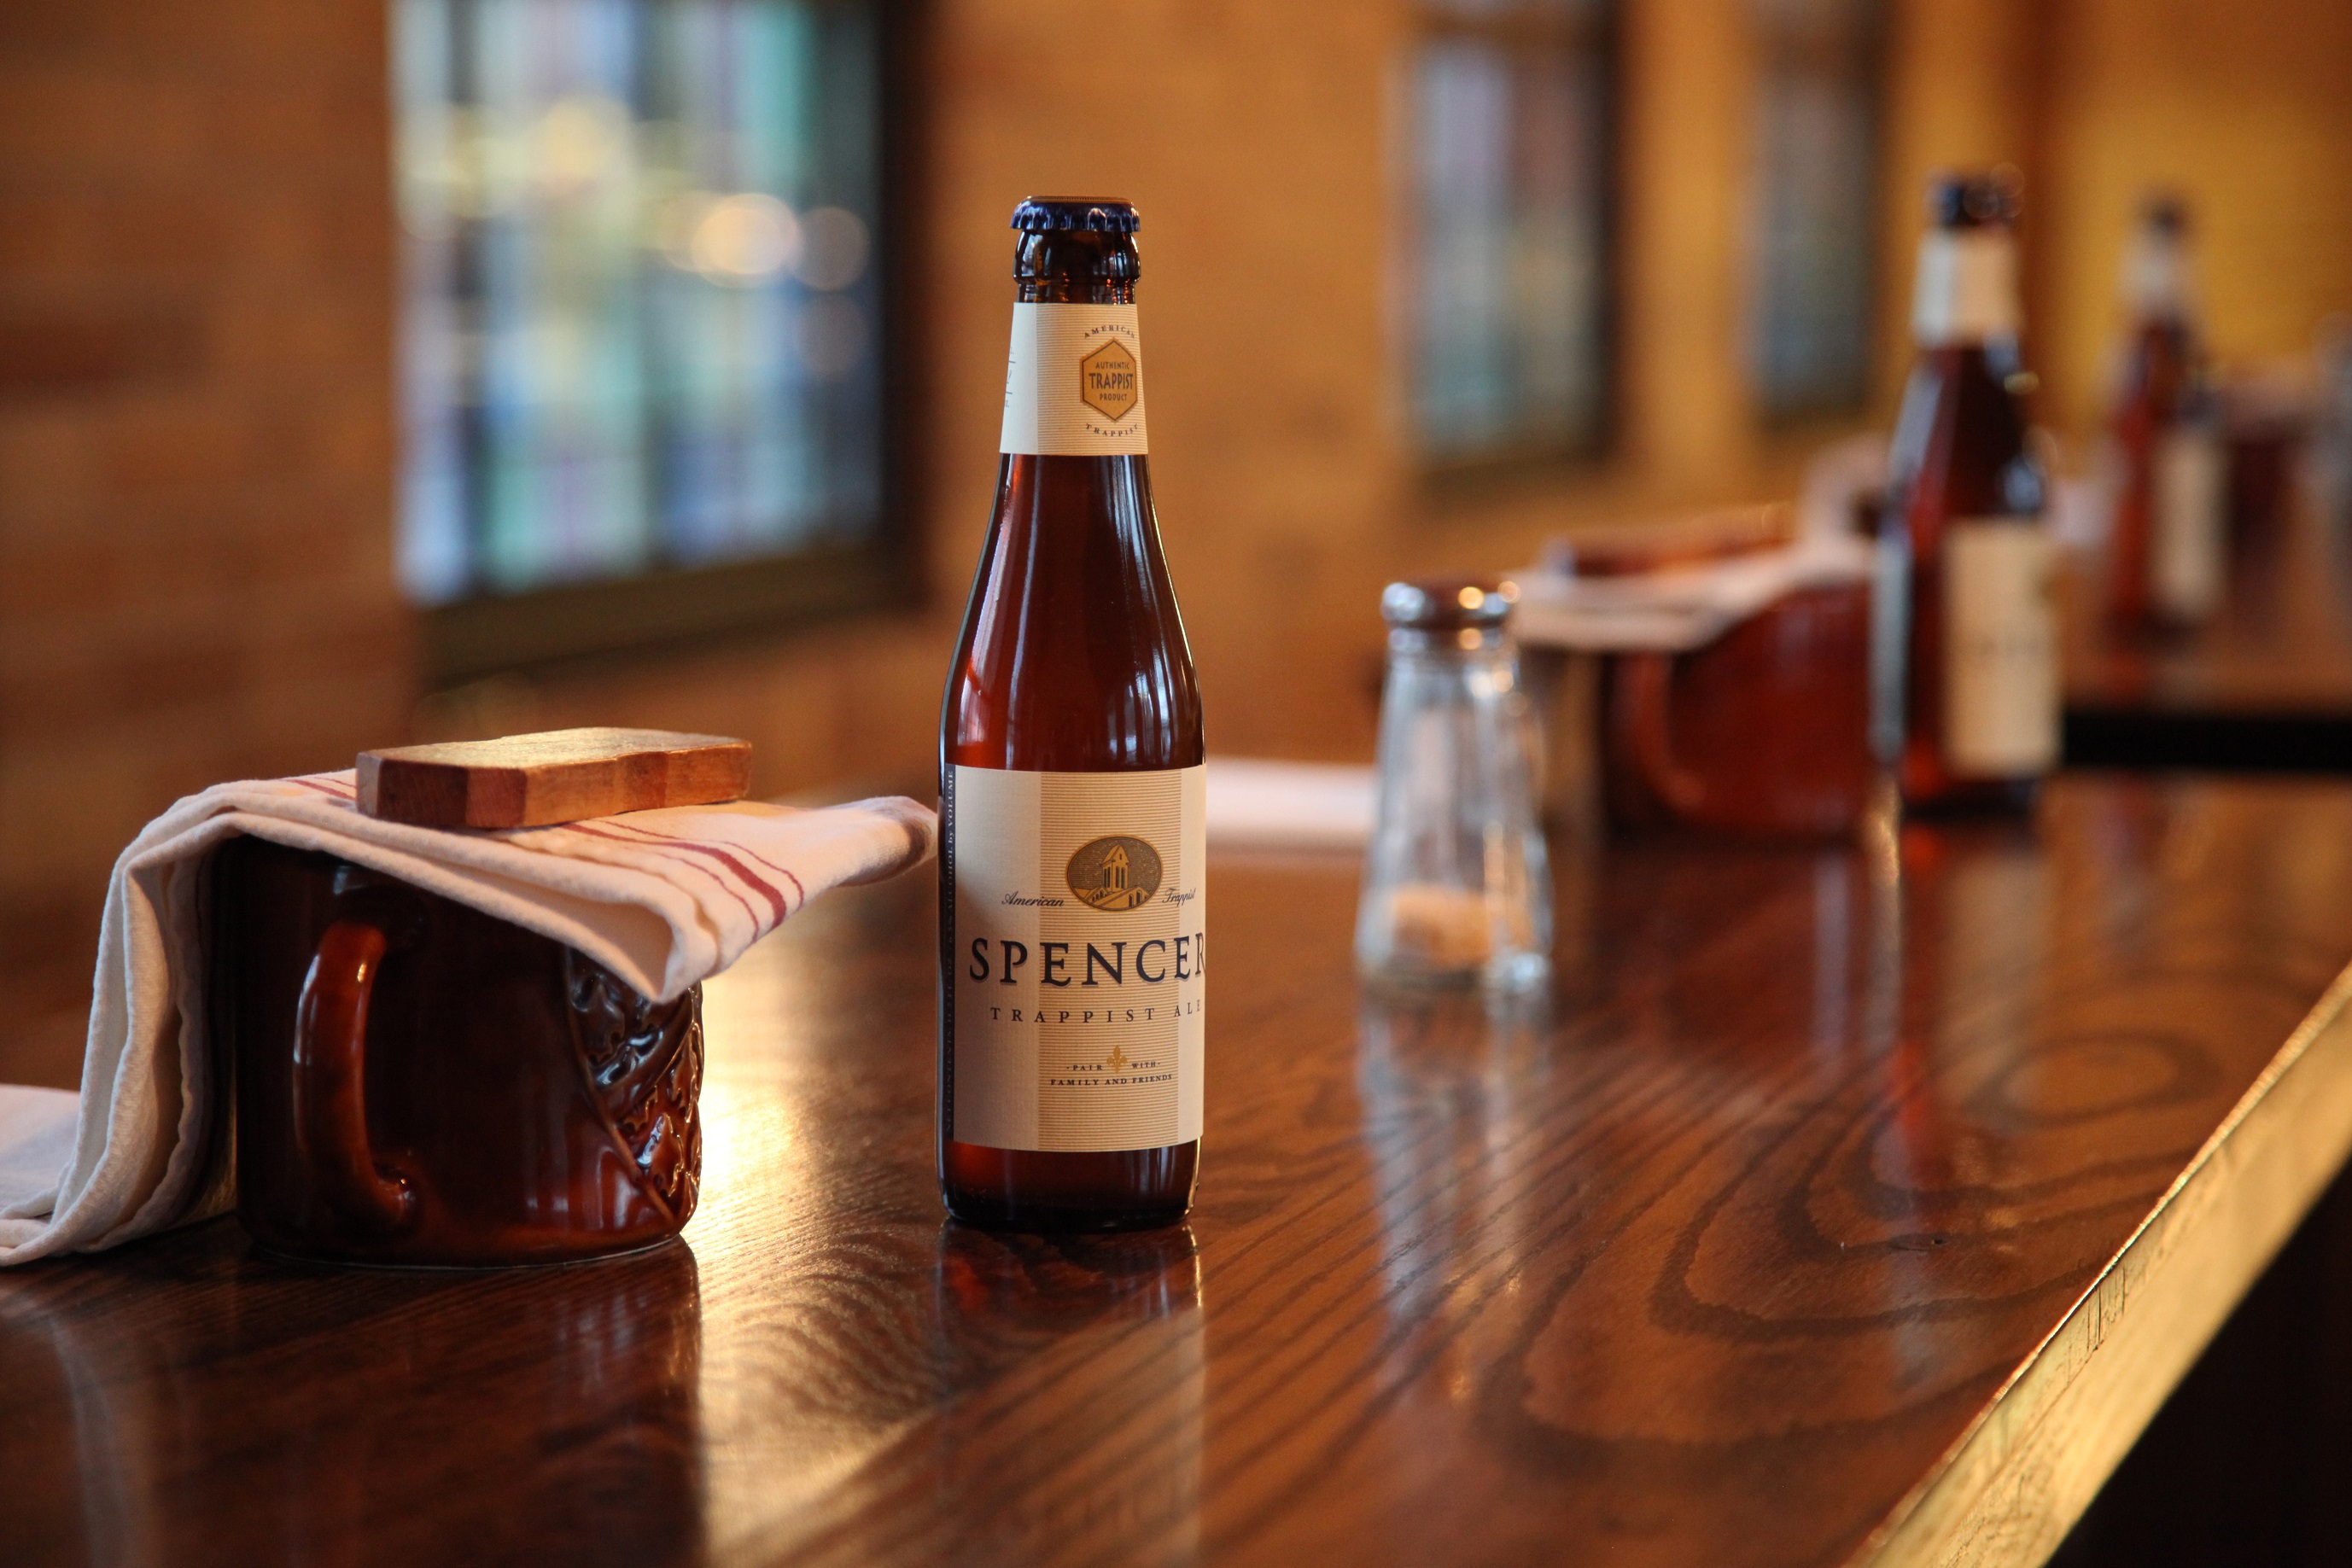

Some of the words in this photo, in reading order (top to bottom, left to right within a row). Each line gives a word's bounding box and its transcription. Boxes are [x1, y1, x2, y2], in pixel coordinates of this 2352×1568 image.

[1095, 361, 1129, 370] AUTHENTIC
[1088, 373, 1134, 389] TRAPPIST
[1100, 393, 1128, 401] PRODUCT
[1085, 423, 1139, 437] TRAPPIST
[1001, 891, 1065, 907] American
[1162, 888, 1196, 906] Trappist
[969, 932, 1205, 988] SPENCER
[990, 1006, 1155, 1023] TRAPPIST
[1174, 999, 1201, 1017] ALE
[1131, 1061, 1157, 1070] WITH
[1105, 1077, 1128, 1086] AND
[1132, 1073, 1173, 1084] FRIENDS
